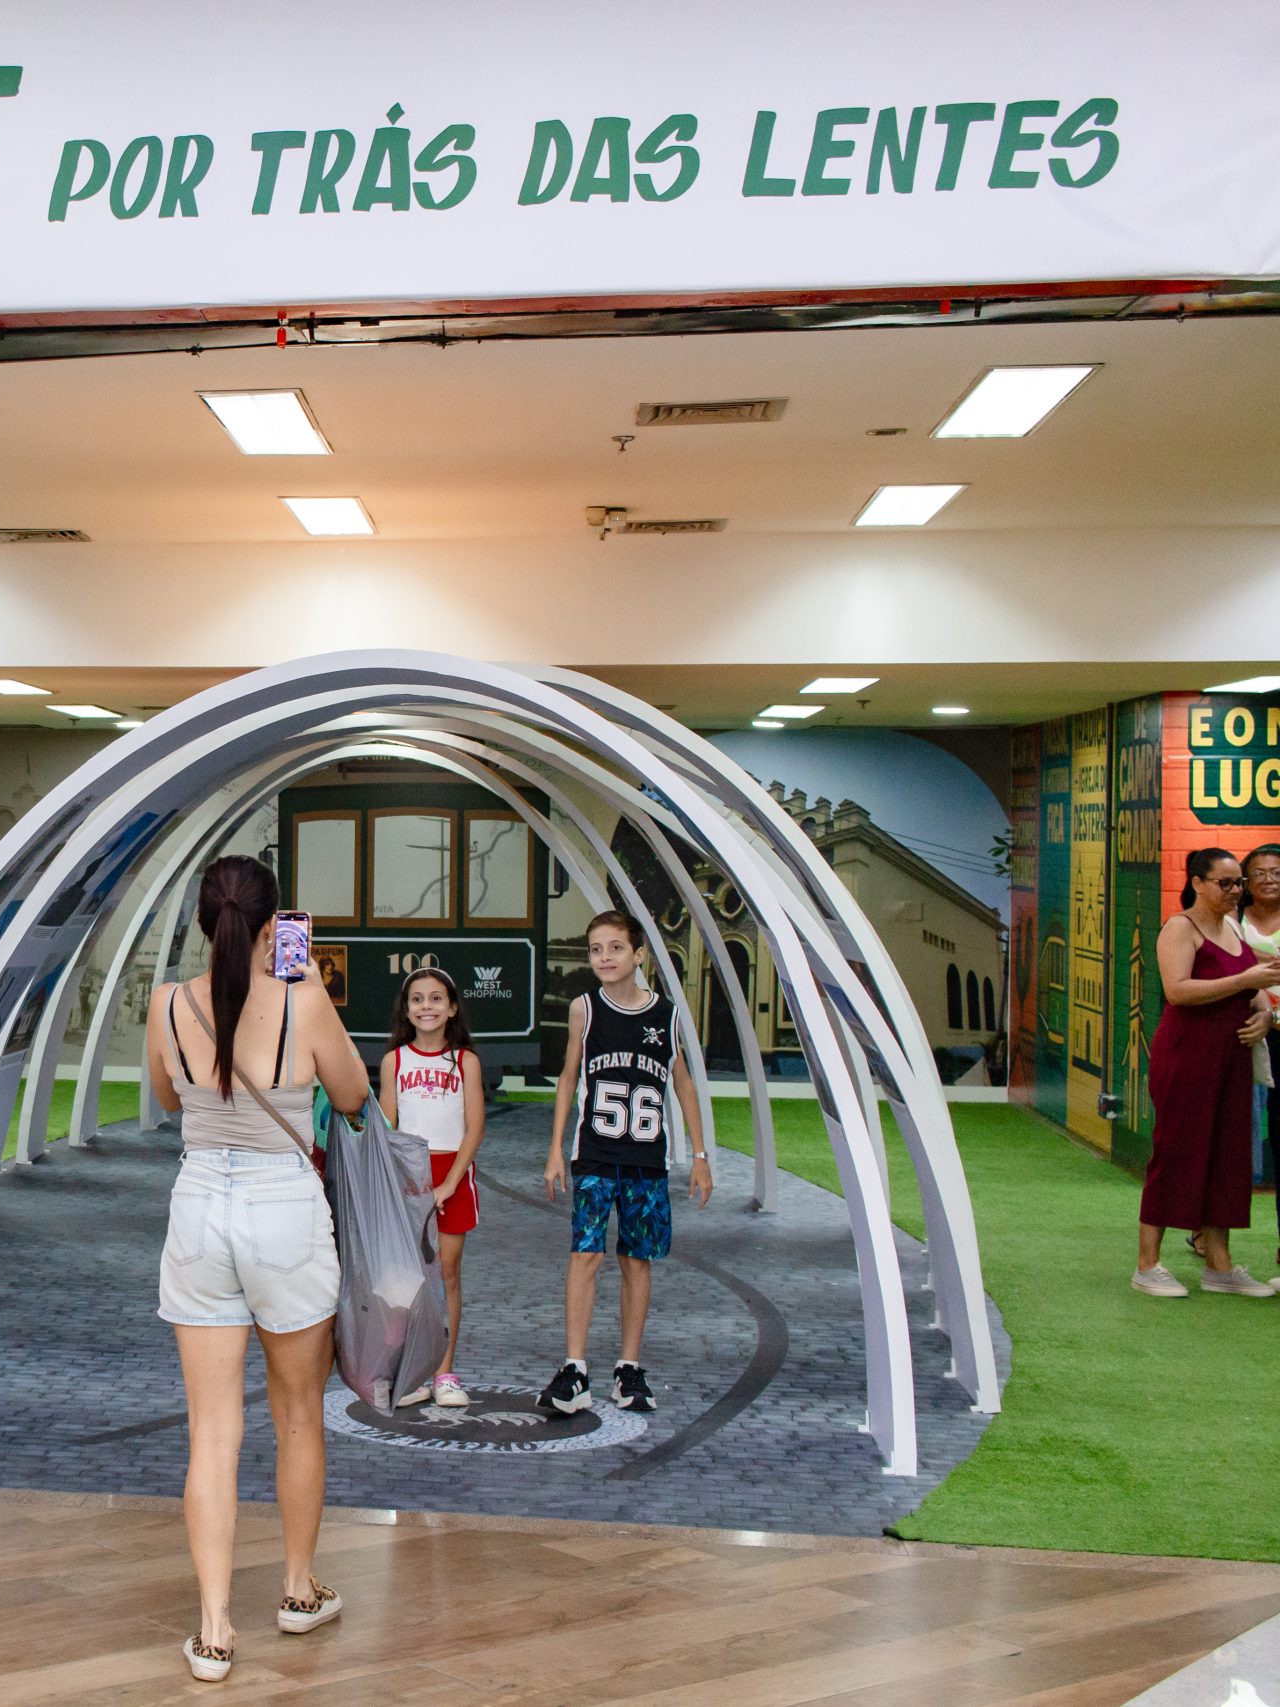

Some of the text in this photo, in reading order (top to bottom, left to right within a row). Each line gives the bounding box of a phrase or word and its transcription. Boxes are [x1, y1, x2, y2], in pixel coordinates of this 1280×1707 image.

[48, 134, 214, 223] POR
[251, 102, 478, 216] TRÁS
[517, 113, 700, 206] DAS
[741, 97, 1121, 198] LENTES
[1224, 707, 1255, 747] O
[1074, 803, 1106, 841] DESTERR
[1119, 809, 1161, 862] GRANDE
[311, 948, 345, 956] PARFUM
[463, 989, 513, 999] SHOPPING
[474, 980, 501, 990] WEST
[400, 1069, 460, 1094] MALIBU
[588, 1051, 668, 1083] STRAW HATS
[591, 1079, 663, 1142] 56
